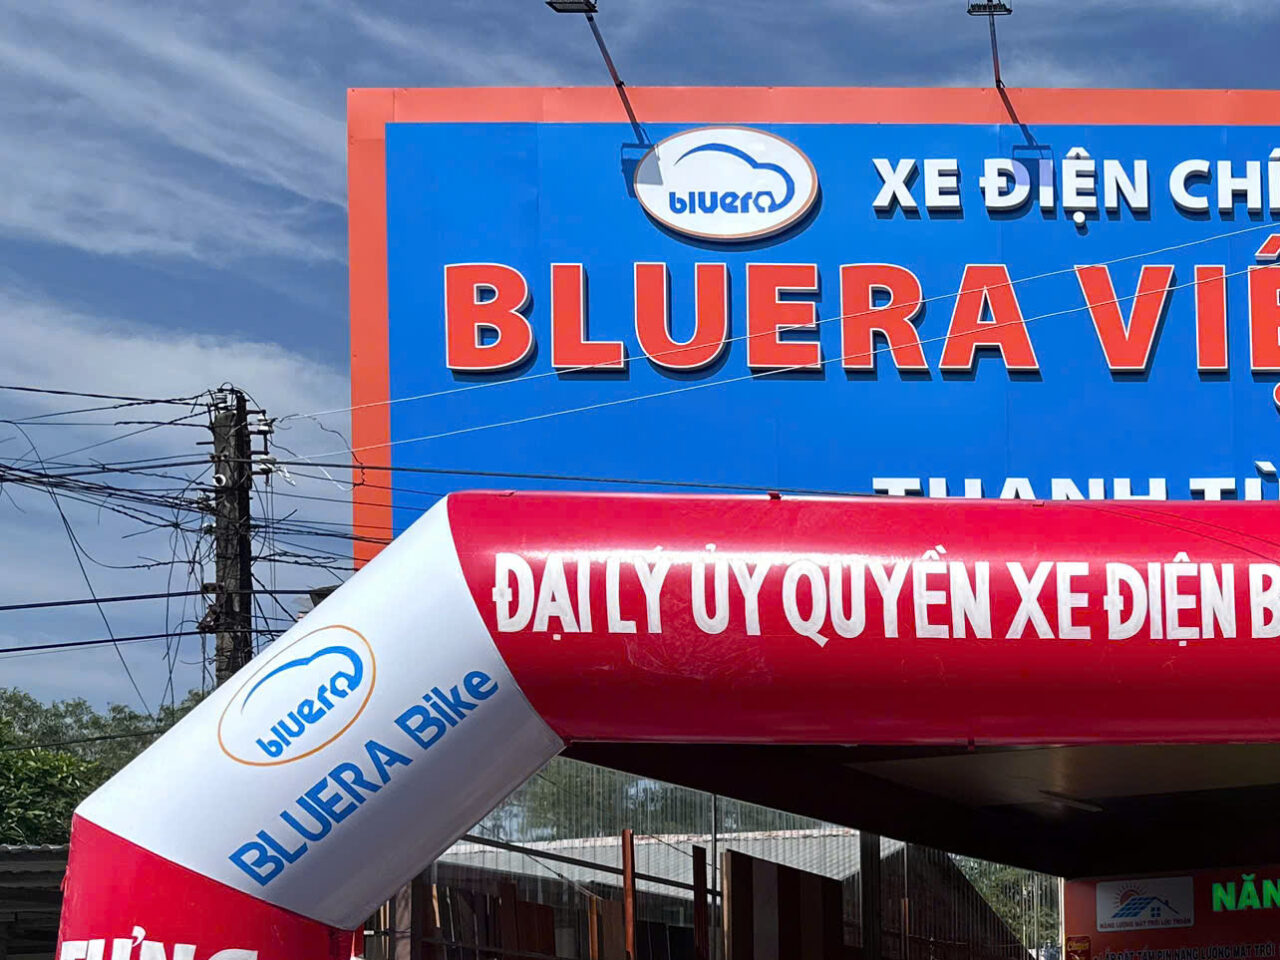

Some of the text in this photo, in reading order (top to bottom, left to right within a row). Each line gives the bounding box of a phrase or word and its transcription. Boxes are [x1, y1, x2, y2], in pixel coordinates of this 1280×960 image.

[872, 157, 962, 210] XE
[980, 147, 1148, 226] ĐIỆN
[444, 262, 1040, 373] BLUERA
[492, 552, 592, 641] ĐẠI
[605, 545, 671, 634] LÝ
[692, 543, 769, 636] ỦY
[782, 544, 990, 648] QUYỀN
[1005, 561, 1091, 640] XE
[1104, 551, 1236, 647] ĐIỆN
[228, 670, 499, 887] BLUERA Bike
